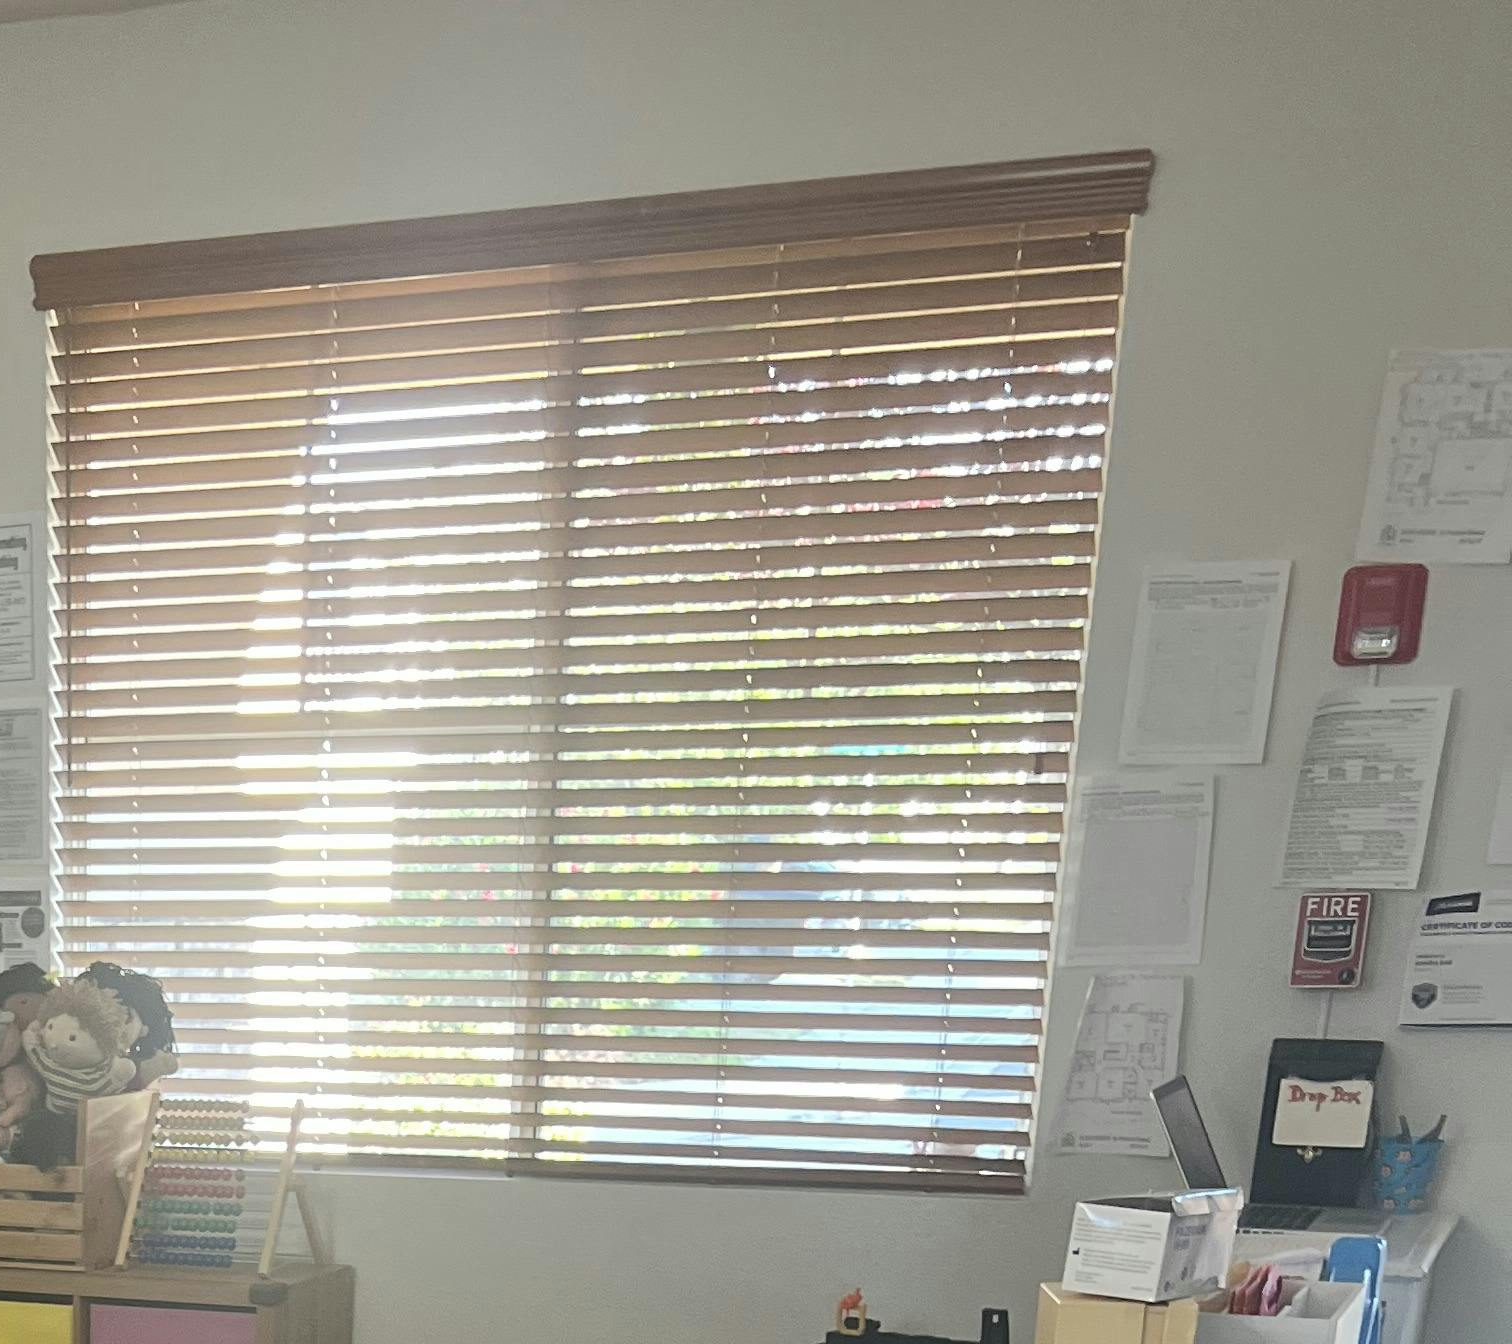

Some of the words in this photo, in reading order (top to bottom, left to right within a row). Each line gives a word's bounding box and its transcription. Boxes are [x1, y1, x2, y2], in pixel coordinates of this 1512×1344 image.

[1306, 897, 1361, 916] FIRE
[1288, 1085, 1328, 1112] Drop
[1330, 1086, 1361, 1104] Box
